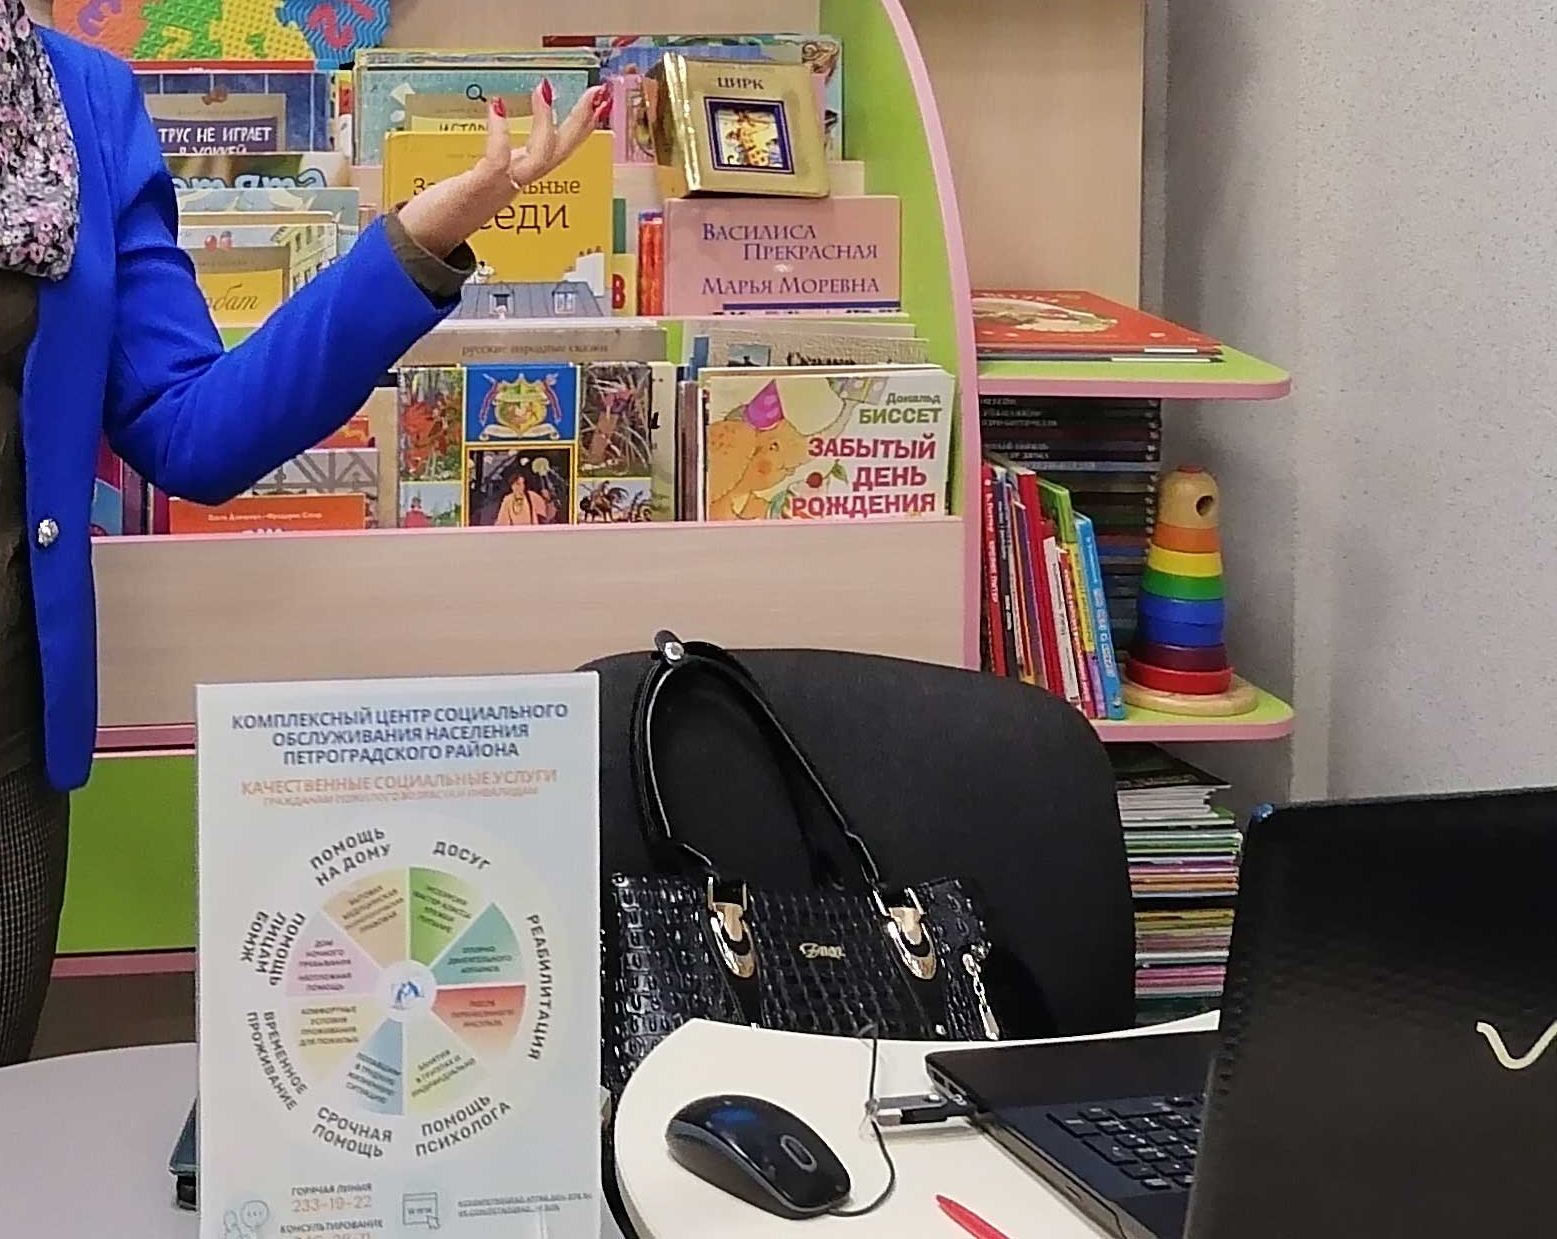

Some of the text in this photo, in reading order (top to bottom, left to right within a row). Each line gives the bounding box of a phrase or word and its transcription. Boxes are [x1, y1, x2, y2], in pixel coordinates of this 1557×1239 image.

[717, 76, 764, 91] ЦИРК
[159, 126, 272, 143] ТРУС НЕ ИГРАЕТ
[858, 407, 943, 425] БИССЕТ
[808, 433, 936, 459] ЗАБЫТЫЙ
[852, 466, 928, 492] ДЕНЬ
[791, 492, 936, 519] РОЖДЕНИЯ
[232, 703, 569, 730] КОМПЛЕКСНЫЙ ЦЕНТР СОЦИАЛЬНОГО
[272, 724, 530, 747] ОБСЛУЖИВАНИЯ НАСЕЛЕНИЯ
[283, 741, 520, 766] ПЕТРОГРАДСКОГО РАЙОНА
[241, 769, 558, 795] КАЧЕСТВЕННЫЕ СОЦИАЛЬНЫЕ УСЛУГИ
[309, 827, 386, 871] ПОМОЩЬ
[315, 843, 392, 887] НА ДОМУ
[432, 840, 492, 871] ДОСУГ
[240, 911, 270, 963] БОМЖ
[255, 911, 286, 975] ЛИЦАМ
[268, 912, 306, 986] ПОМОЩЬ
[526, 914, 555, 1061] РЕАБИЛИТАЦИЯ
[246, 1011, 299, 1111] ПРОЖИВАНИЕ
[264, 1011, 308, 1095] ВРЕМЕННОЕ
[316, 1106, 393, 1143] СРОЧНАЯ
[415, 1101, 512, 1158] ПСИХОЛОГА
[420, 1093, 492, 1137] ПОМОЩЬ
[311, 1123, 384, 1159] ПОМОЩЬ
